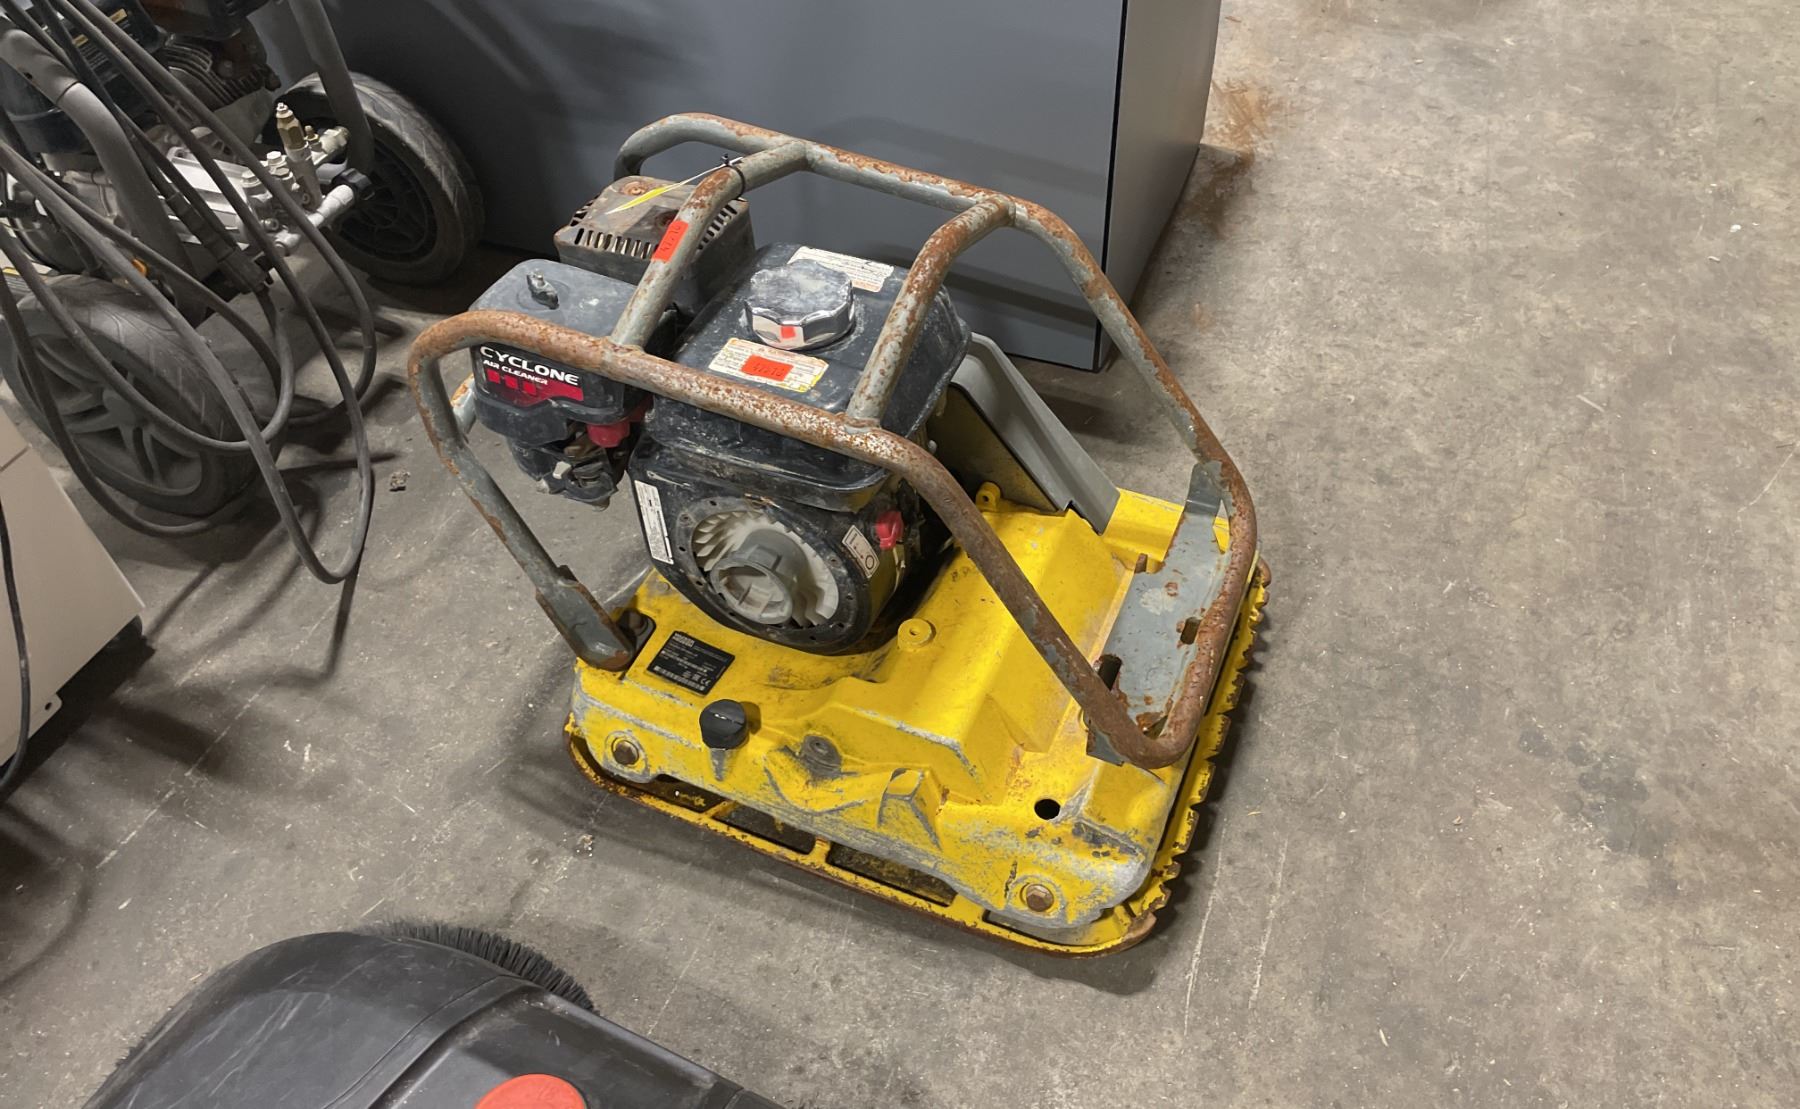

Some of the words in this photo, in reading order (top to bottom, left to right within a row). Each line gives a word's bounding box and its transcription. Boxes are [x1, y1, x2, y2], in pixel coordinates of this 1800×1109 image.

[480, 346, 580, 386] CYCLONE
[483, 359, 500, 370] AIR
[501, 365, 549, 386] CLEANER
